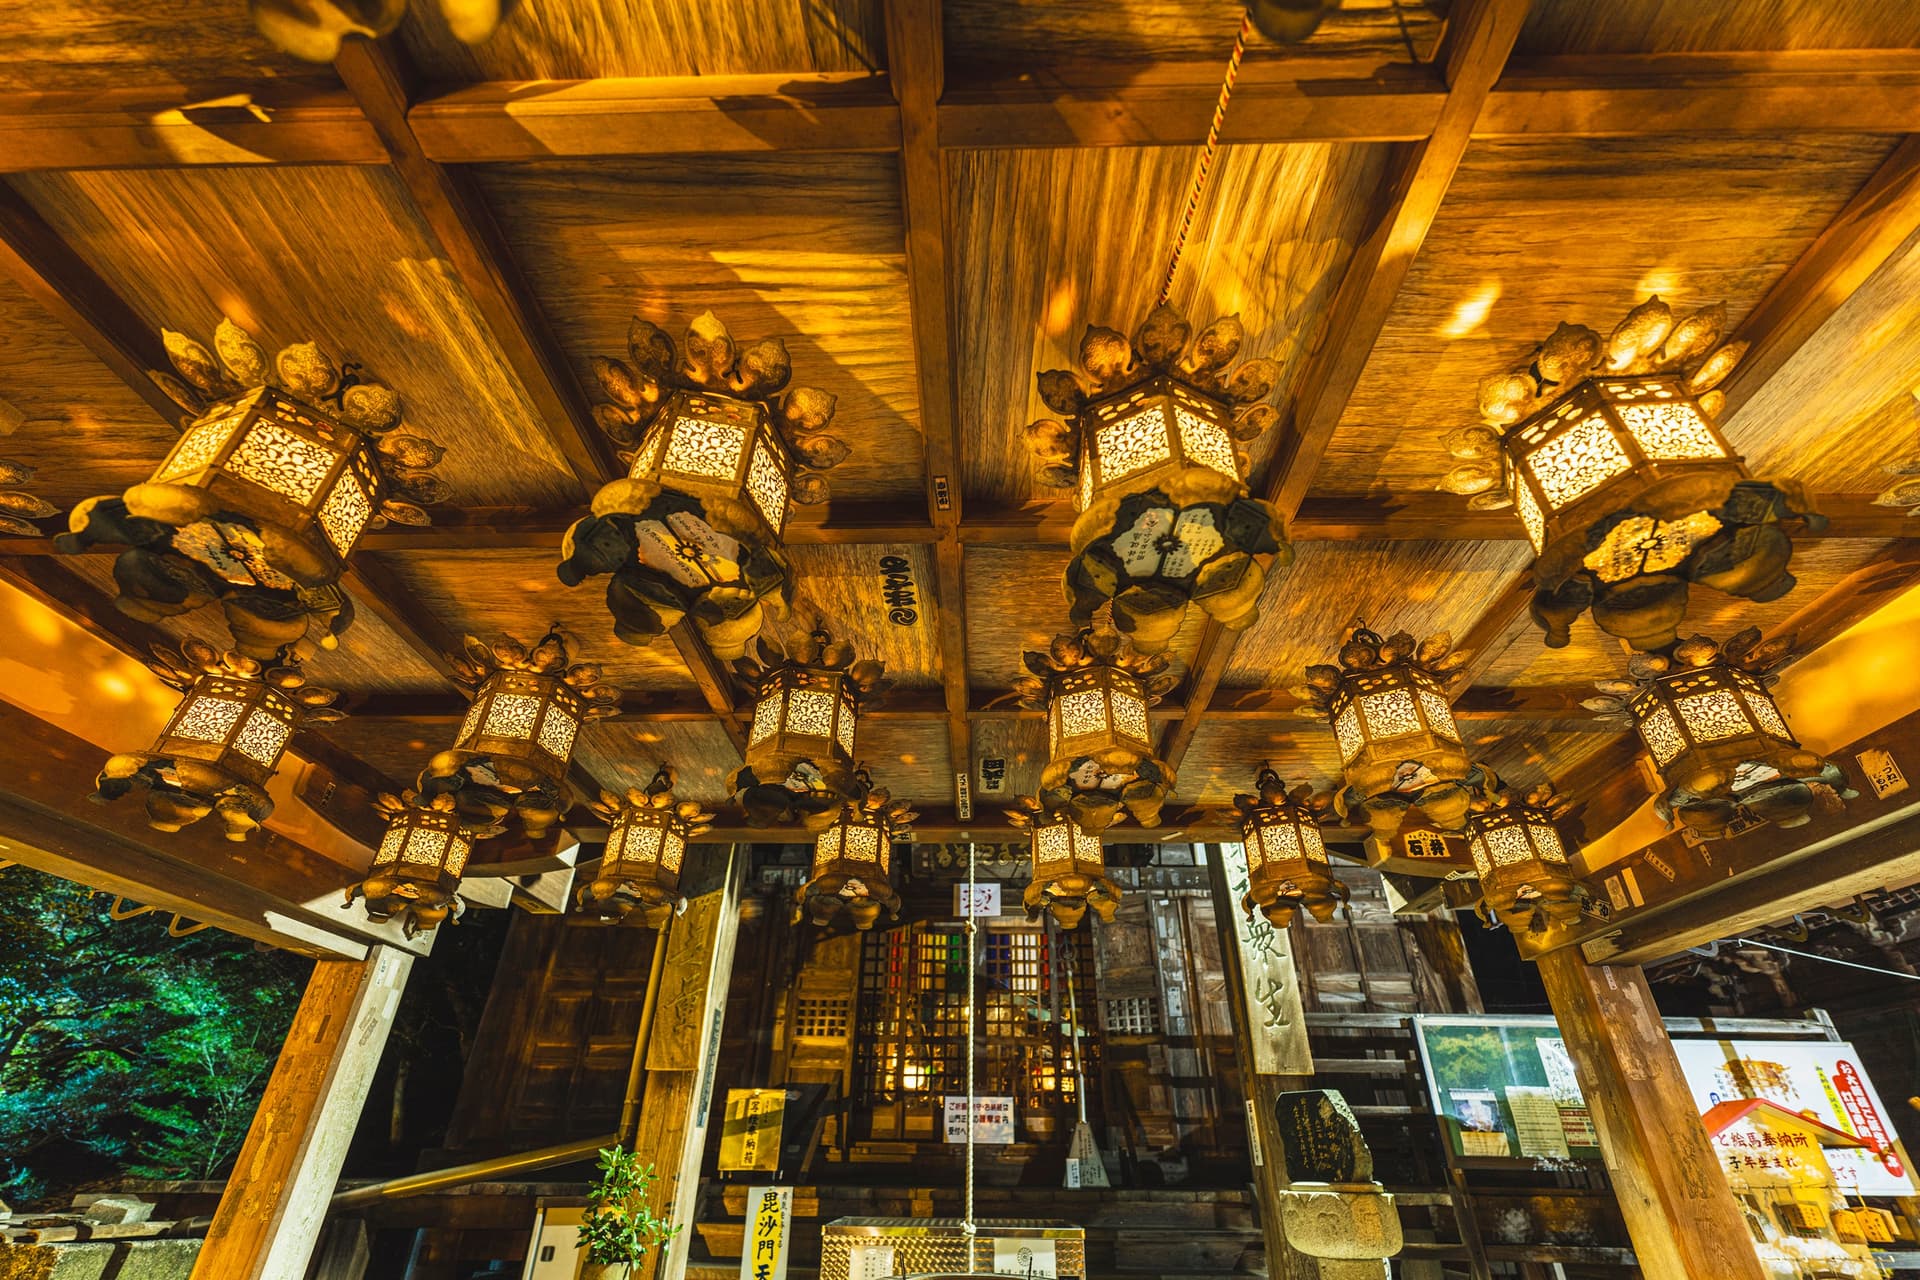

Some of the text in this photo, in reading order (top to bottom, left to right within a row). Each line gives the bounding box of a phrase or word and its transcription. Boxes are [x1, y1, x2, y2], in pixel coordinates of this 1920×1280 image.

[1712, 1131, 1809, 1148] と絵馬奉納所
[1728, 1156, 1799, 1169] 子年生まれ
[754, 1191, 780, 1280] 毘沙門天
